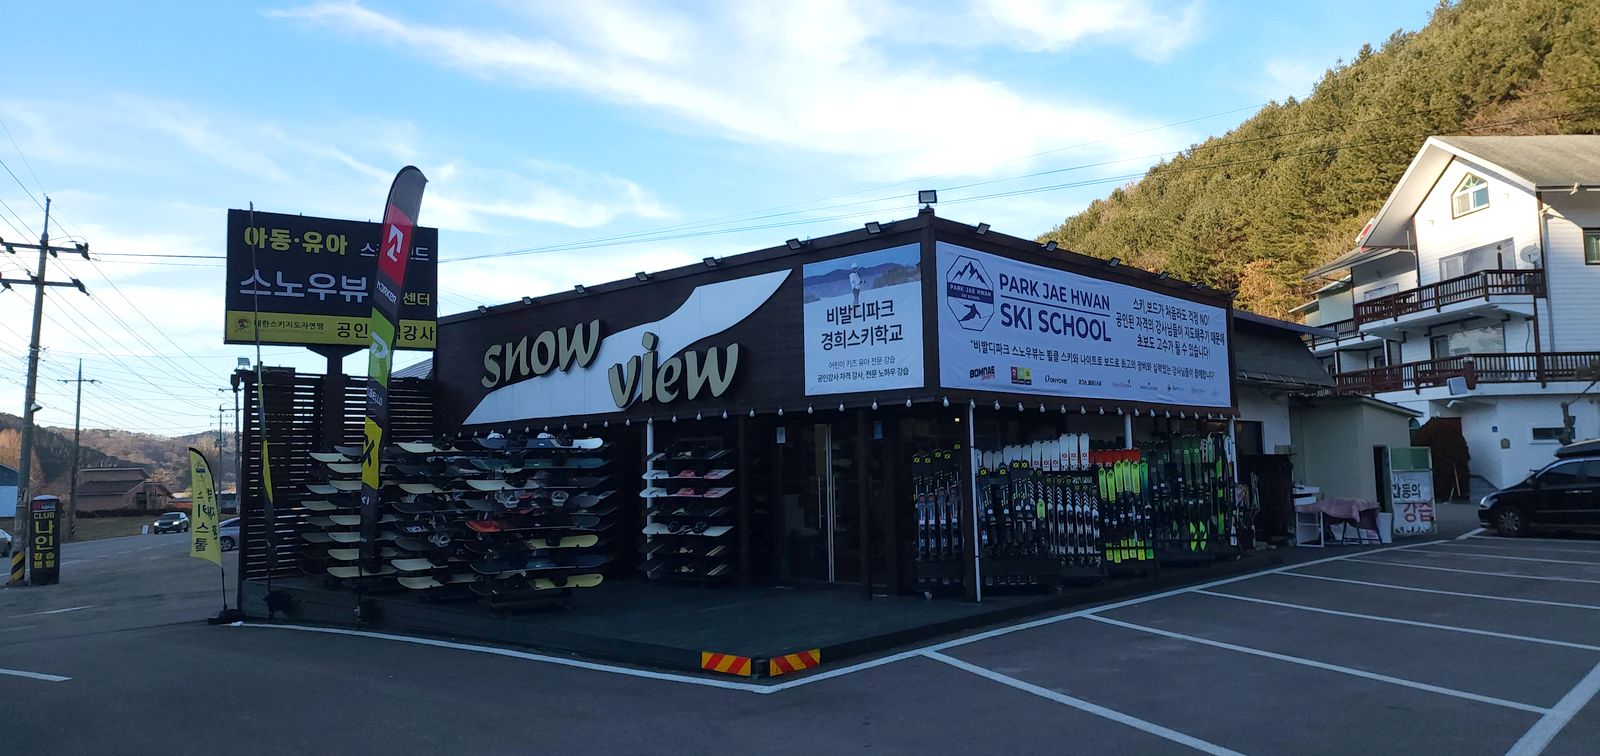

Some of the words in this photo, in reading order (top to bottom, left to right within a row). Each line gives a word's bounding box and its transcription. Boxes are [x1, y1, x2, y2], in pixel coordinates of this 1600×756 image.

[239, 269, 369, 303] 스노우뷰
[999, 273, 1039, 298] PARK
[1042, 282, 1067, 303] JAE
[1071, 289, 1110, 312] HWAN
[826, 299, 895, 326] 비발디파크
[1000, 302, 1032, 331] SKI
[1038, 309, 1112, 341] SCHOOL
[1115, 311, 1135, 330] 공인된
[1136, 316, 1154, 334] 자격의
[1155, 320, 1183, 339] 강사님들이
[821, 323, 904, 351] 경희스키학교
[1137, 333, 1155, 350] 초보도
[1156, 338, 1174, 354] 고수가
[1011, 344, 1045, 361] 스노우뷰는
[1061, 351, 1079, 364] 스키와
[33, 512, 55, 520] CLUB
[34, 519, 55, 551] 나인
